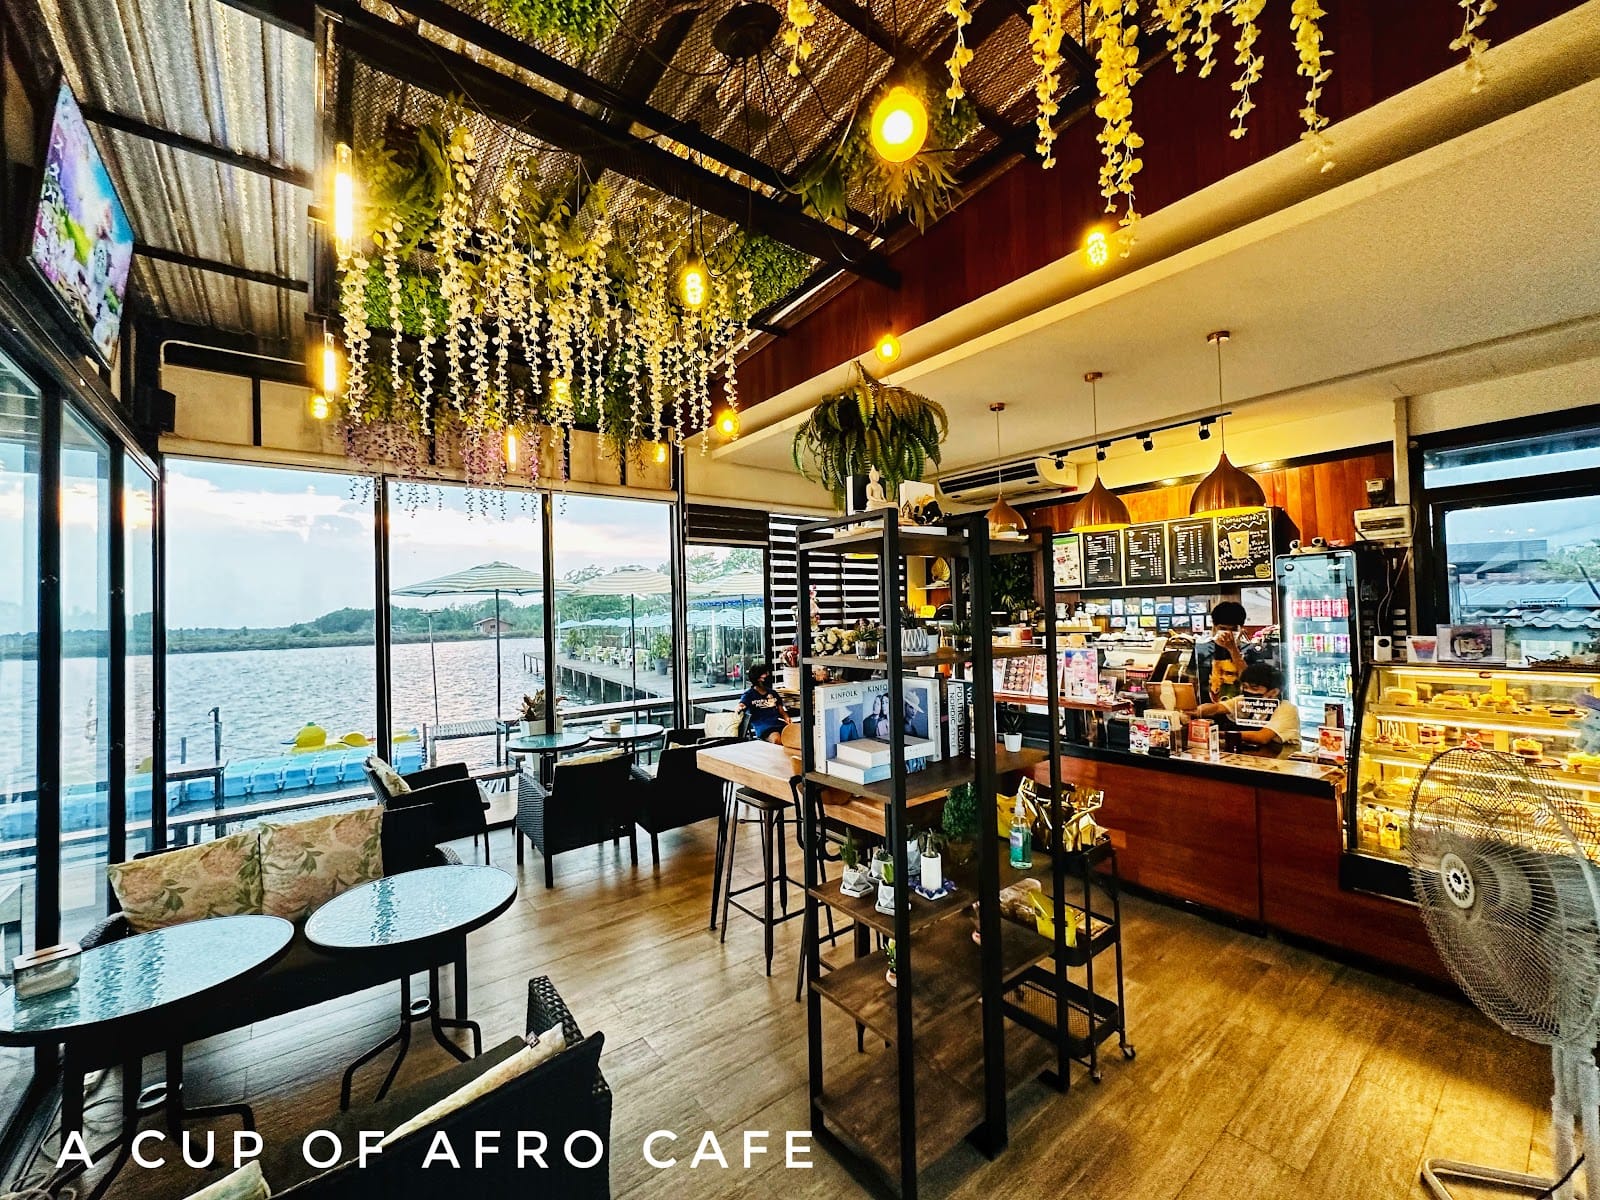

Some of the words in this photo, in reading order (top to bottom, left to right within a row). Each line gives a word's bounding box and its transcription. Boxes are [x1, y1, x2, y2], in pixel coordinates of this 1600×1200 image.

[867, 683, 888, 693] KINFO
[830, 690, 858, 700] KINFOLK
[956, 686, 964, 723] POLITICS
